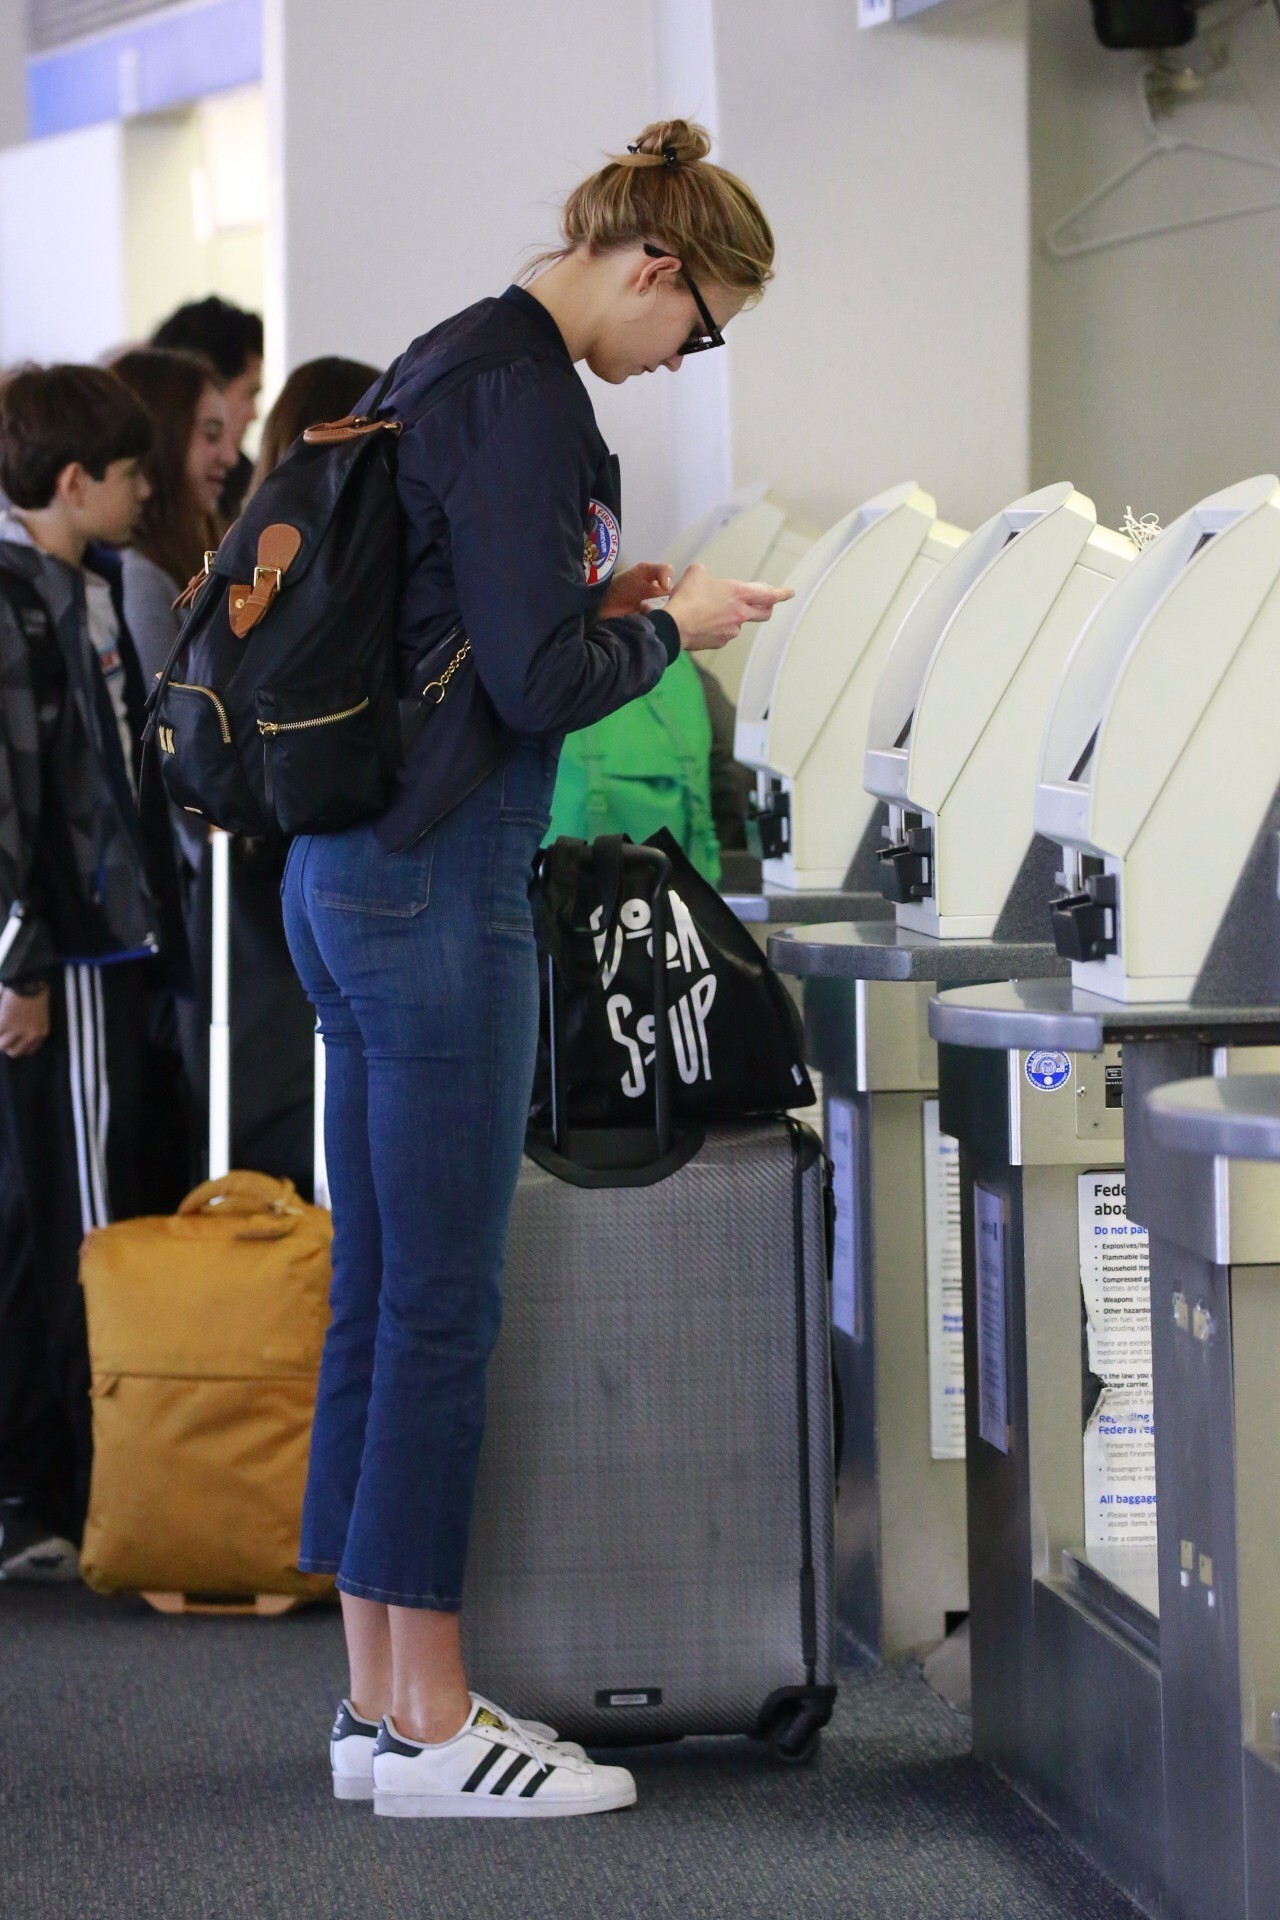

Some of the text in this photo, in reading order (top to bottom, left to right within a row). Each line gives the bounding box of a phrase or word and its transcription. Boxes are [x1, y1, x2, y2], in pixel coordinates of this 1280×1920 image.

[596, 509, 618, 563] FIRST OF ALL
[1094, 1226, 1108, 1235] Do
[1111, 1226, 1128, 1235] not
[1102, 1276, 1142, 1284] Compressed
[1100, 1494, 1113, 1504] All
